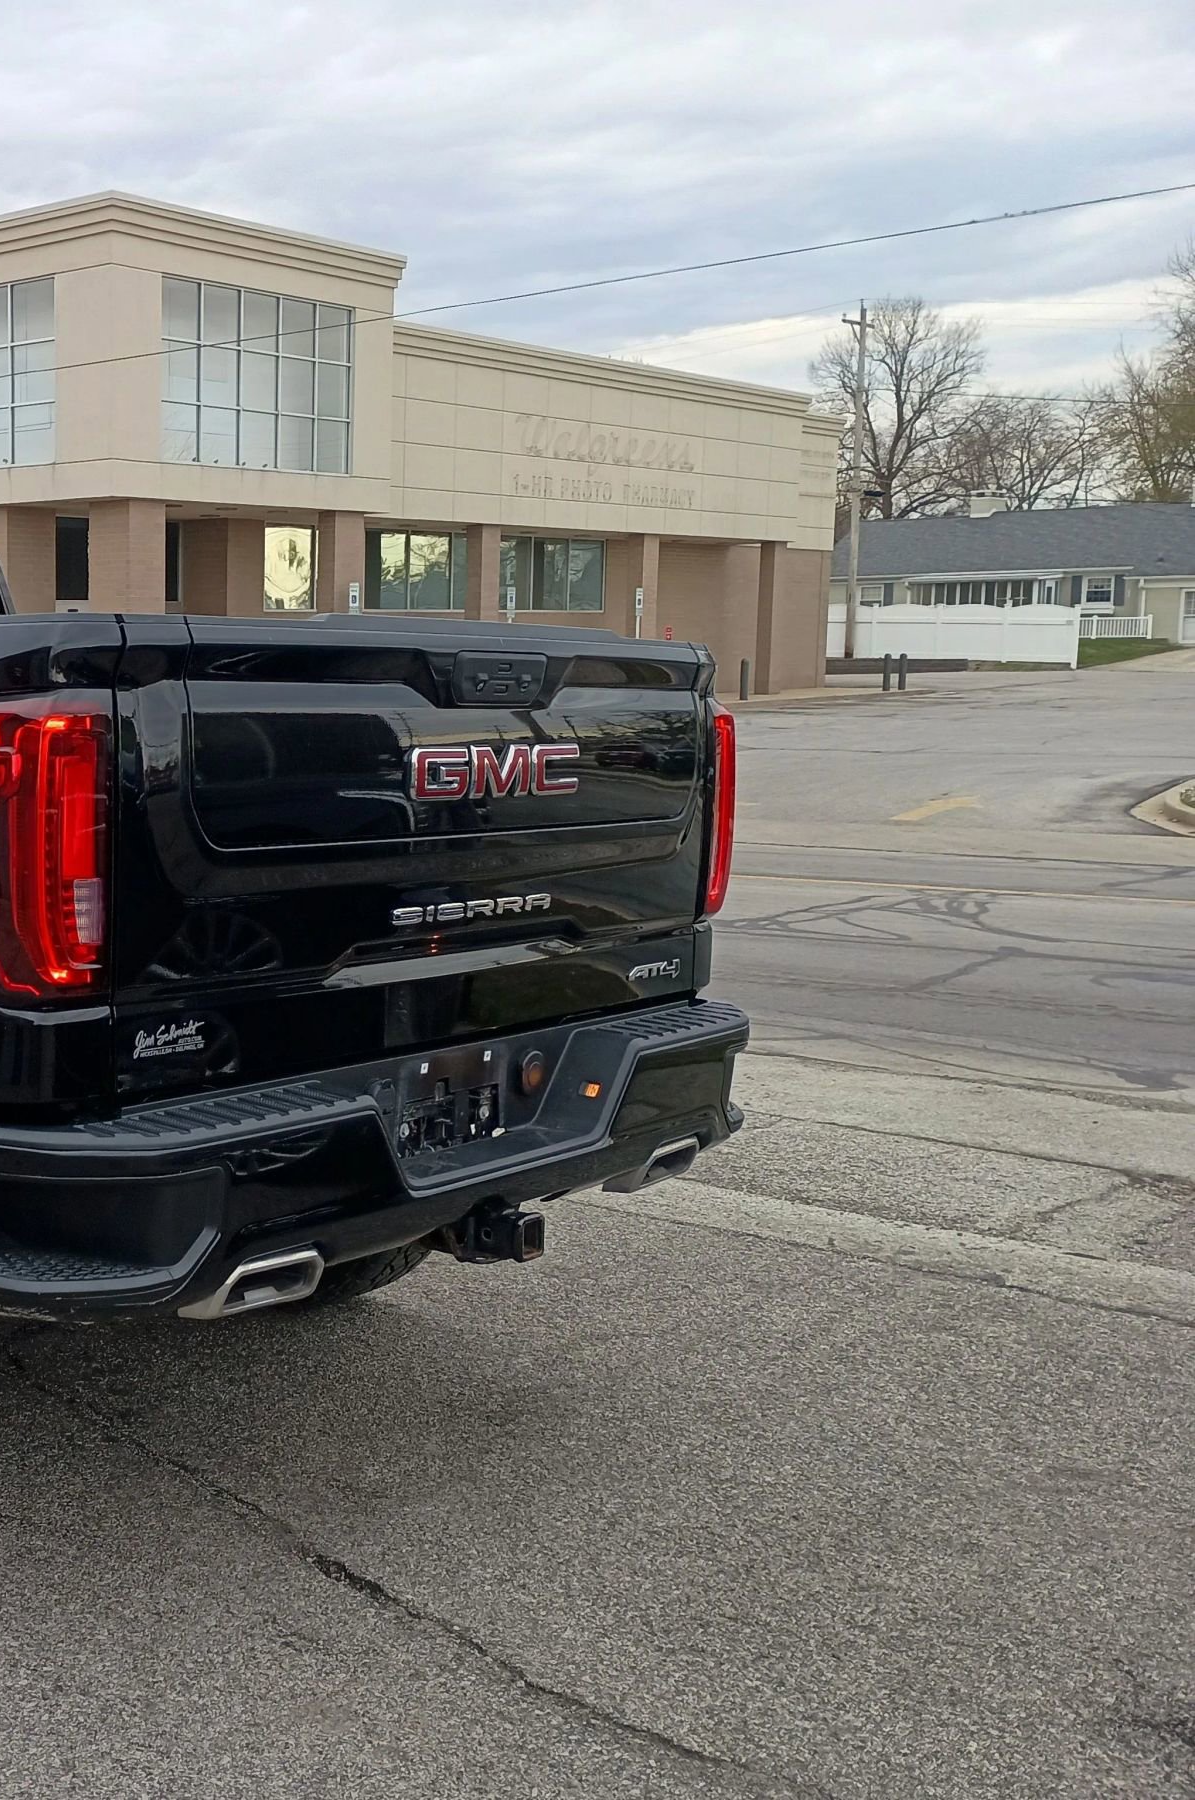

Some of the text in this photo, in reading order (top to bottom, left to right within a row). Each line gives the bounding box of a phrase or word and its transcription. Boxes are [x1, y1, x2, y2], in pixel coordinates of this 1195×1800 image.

[410, 743, 580, 801] GMC
[391, 893, 551, 926] SIERRA
[627, 958, 681, 982] AT4
[133, 1030, 155, 1059] Jim
[156, 1019, 205, 1046] Schmidt
